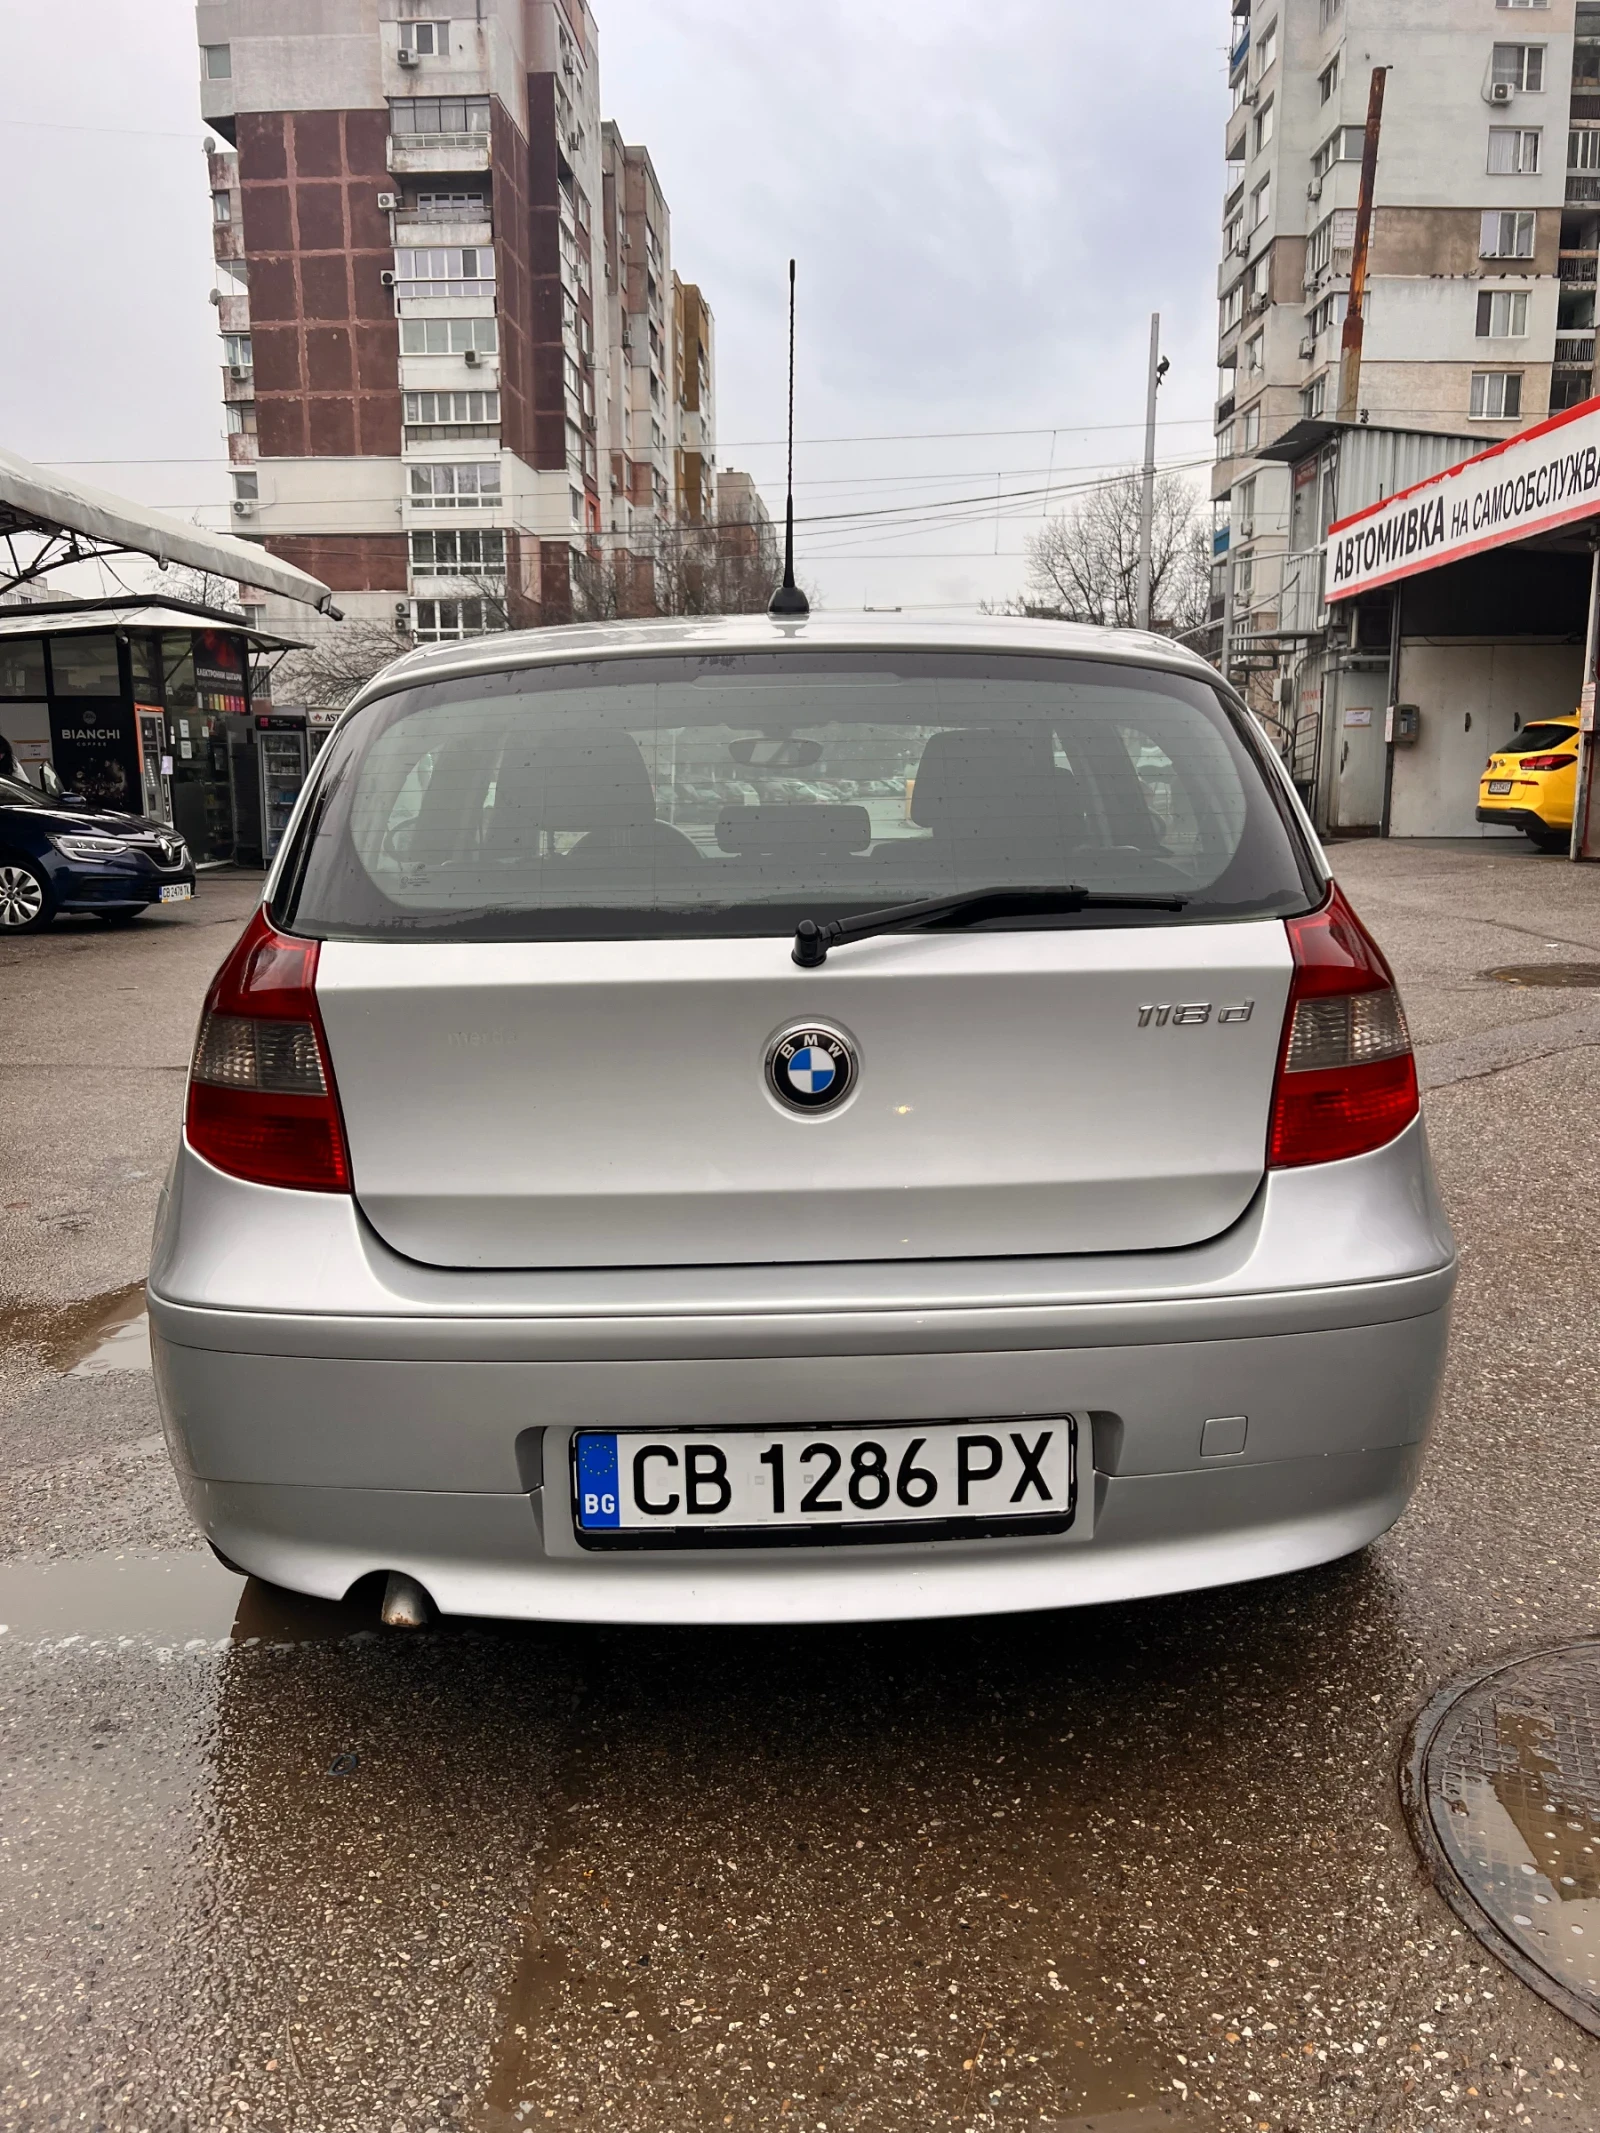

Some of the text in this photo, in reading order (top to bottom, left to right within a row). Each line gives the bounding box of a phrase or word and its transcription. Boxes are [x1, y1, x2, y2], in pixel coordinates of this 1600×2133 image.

[1334, 495, 1444, 583] АВТОМИВКА
[1450, 502, 1468, 539] НА
[61, 729, 120, 740] BIANCHI
[780, 1034, 843, 1060] BMW
[632, 1431, 1054, 1516] CB 1286 PX
[584, 1493, 616, 1515] BG
